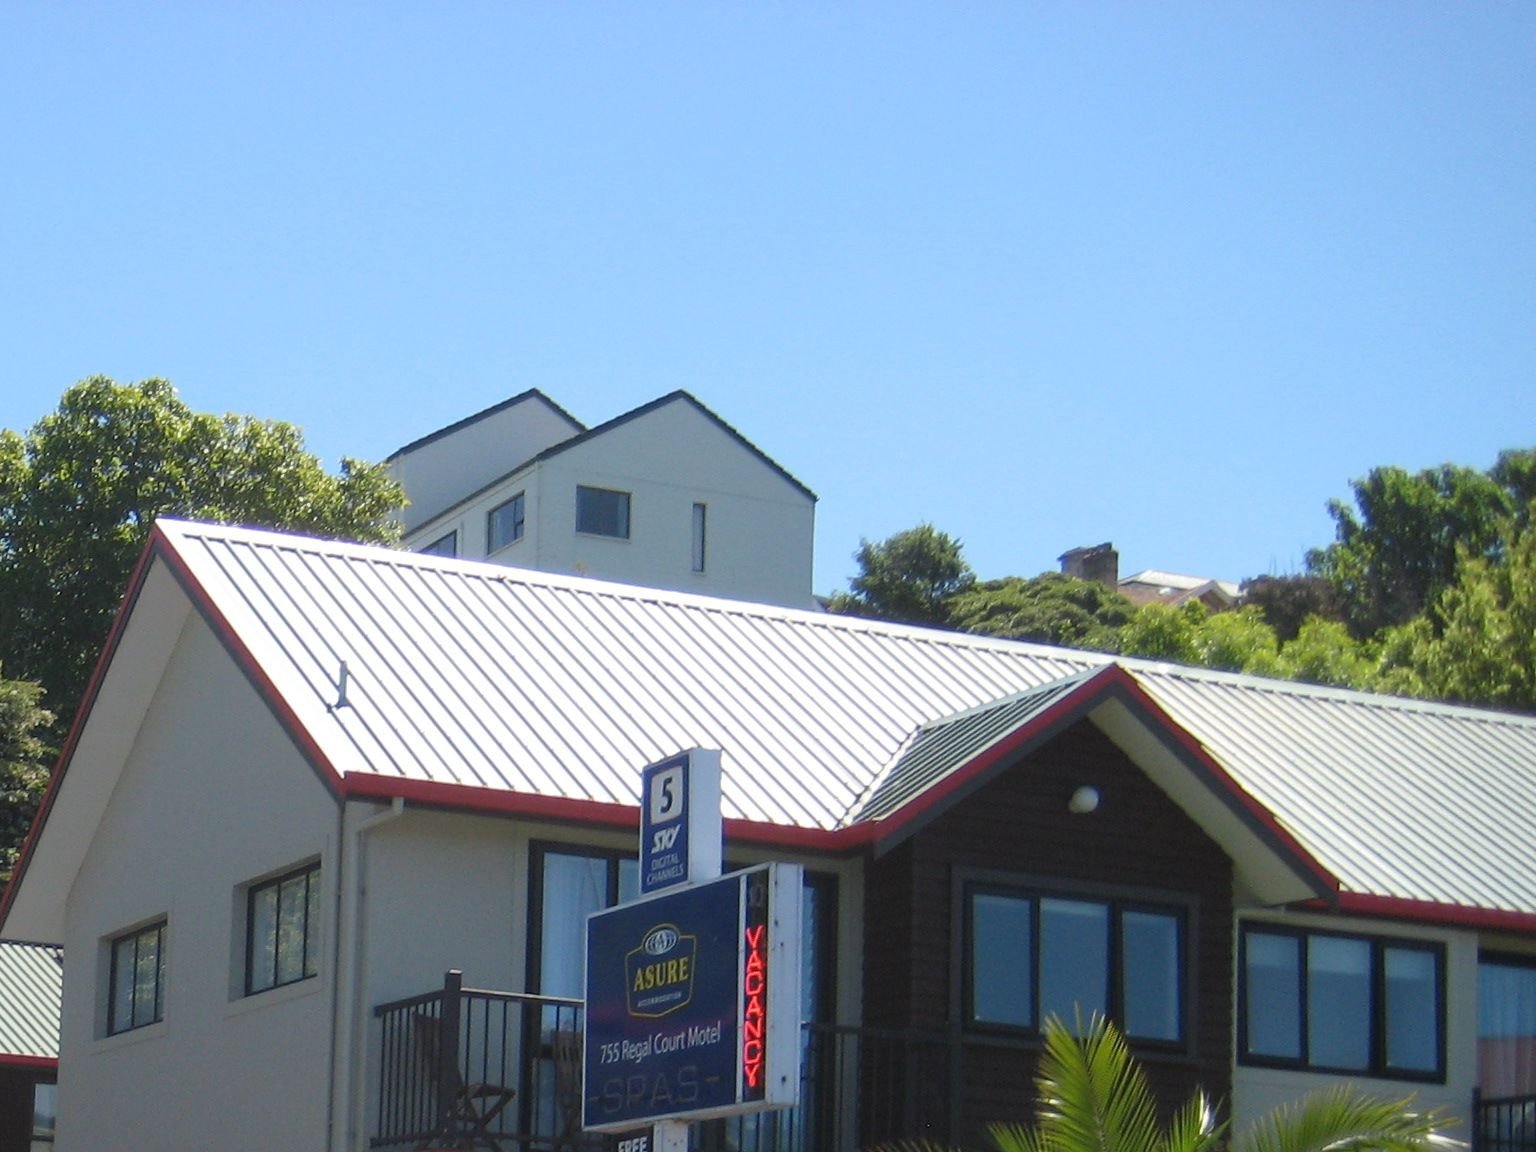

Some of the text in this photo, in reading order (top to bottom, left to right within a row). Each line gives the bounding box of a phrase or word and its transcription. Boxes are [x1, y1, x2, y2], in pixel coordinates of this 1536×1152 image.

[659, 776, 673, 814] 5
[651, 824, 681, 854] SKY
[646, 863, 684, 886] CHANNELS
[651, 852, 680, 871] DIGITAL
[633, 956, 689, 992] ASURE
[744, 925, 763, 1087] VACANCY
[600, 1020, 721, 1065] 755 Regal Court Motel
